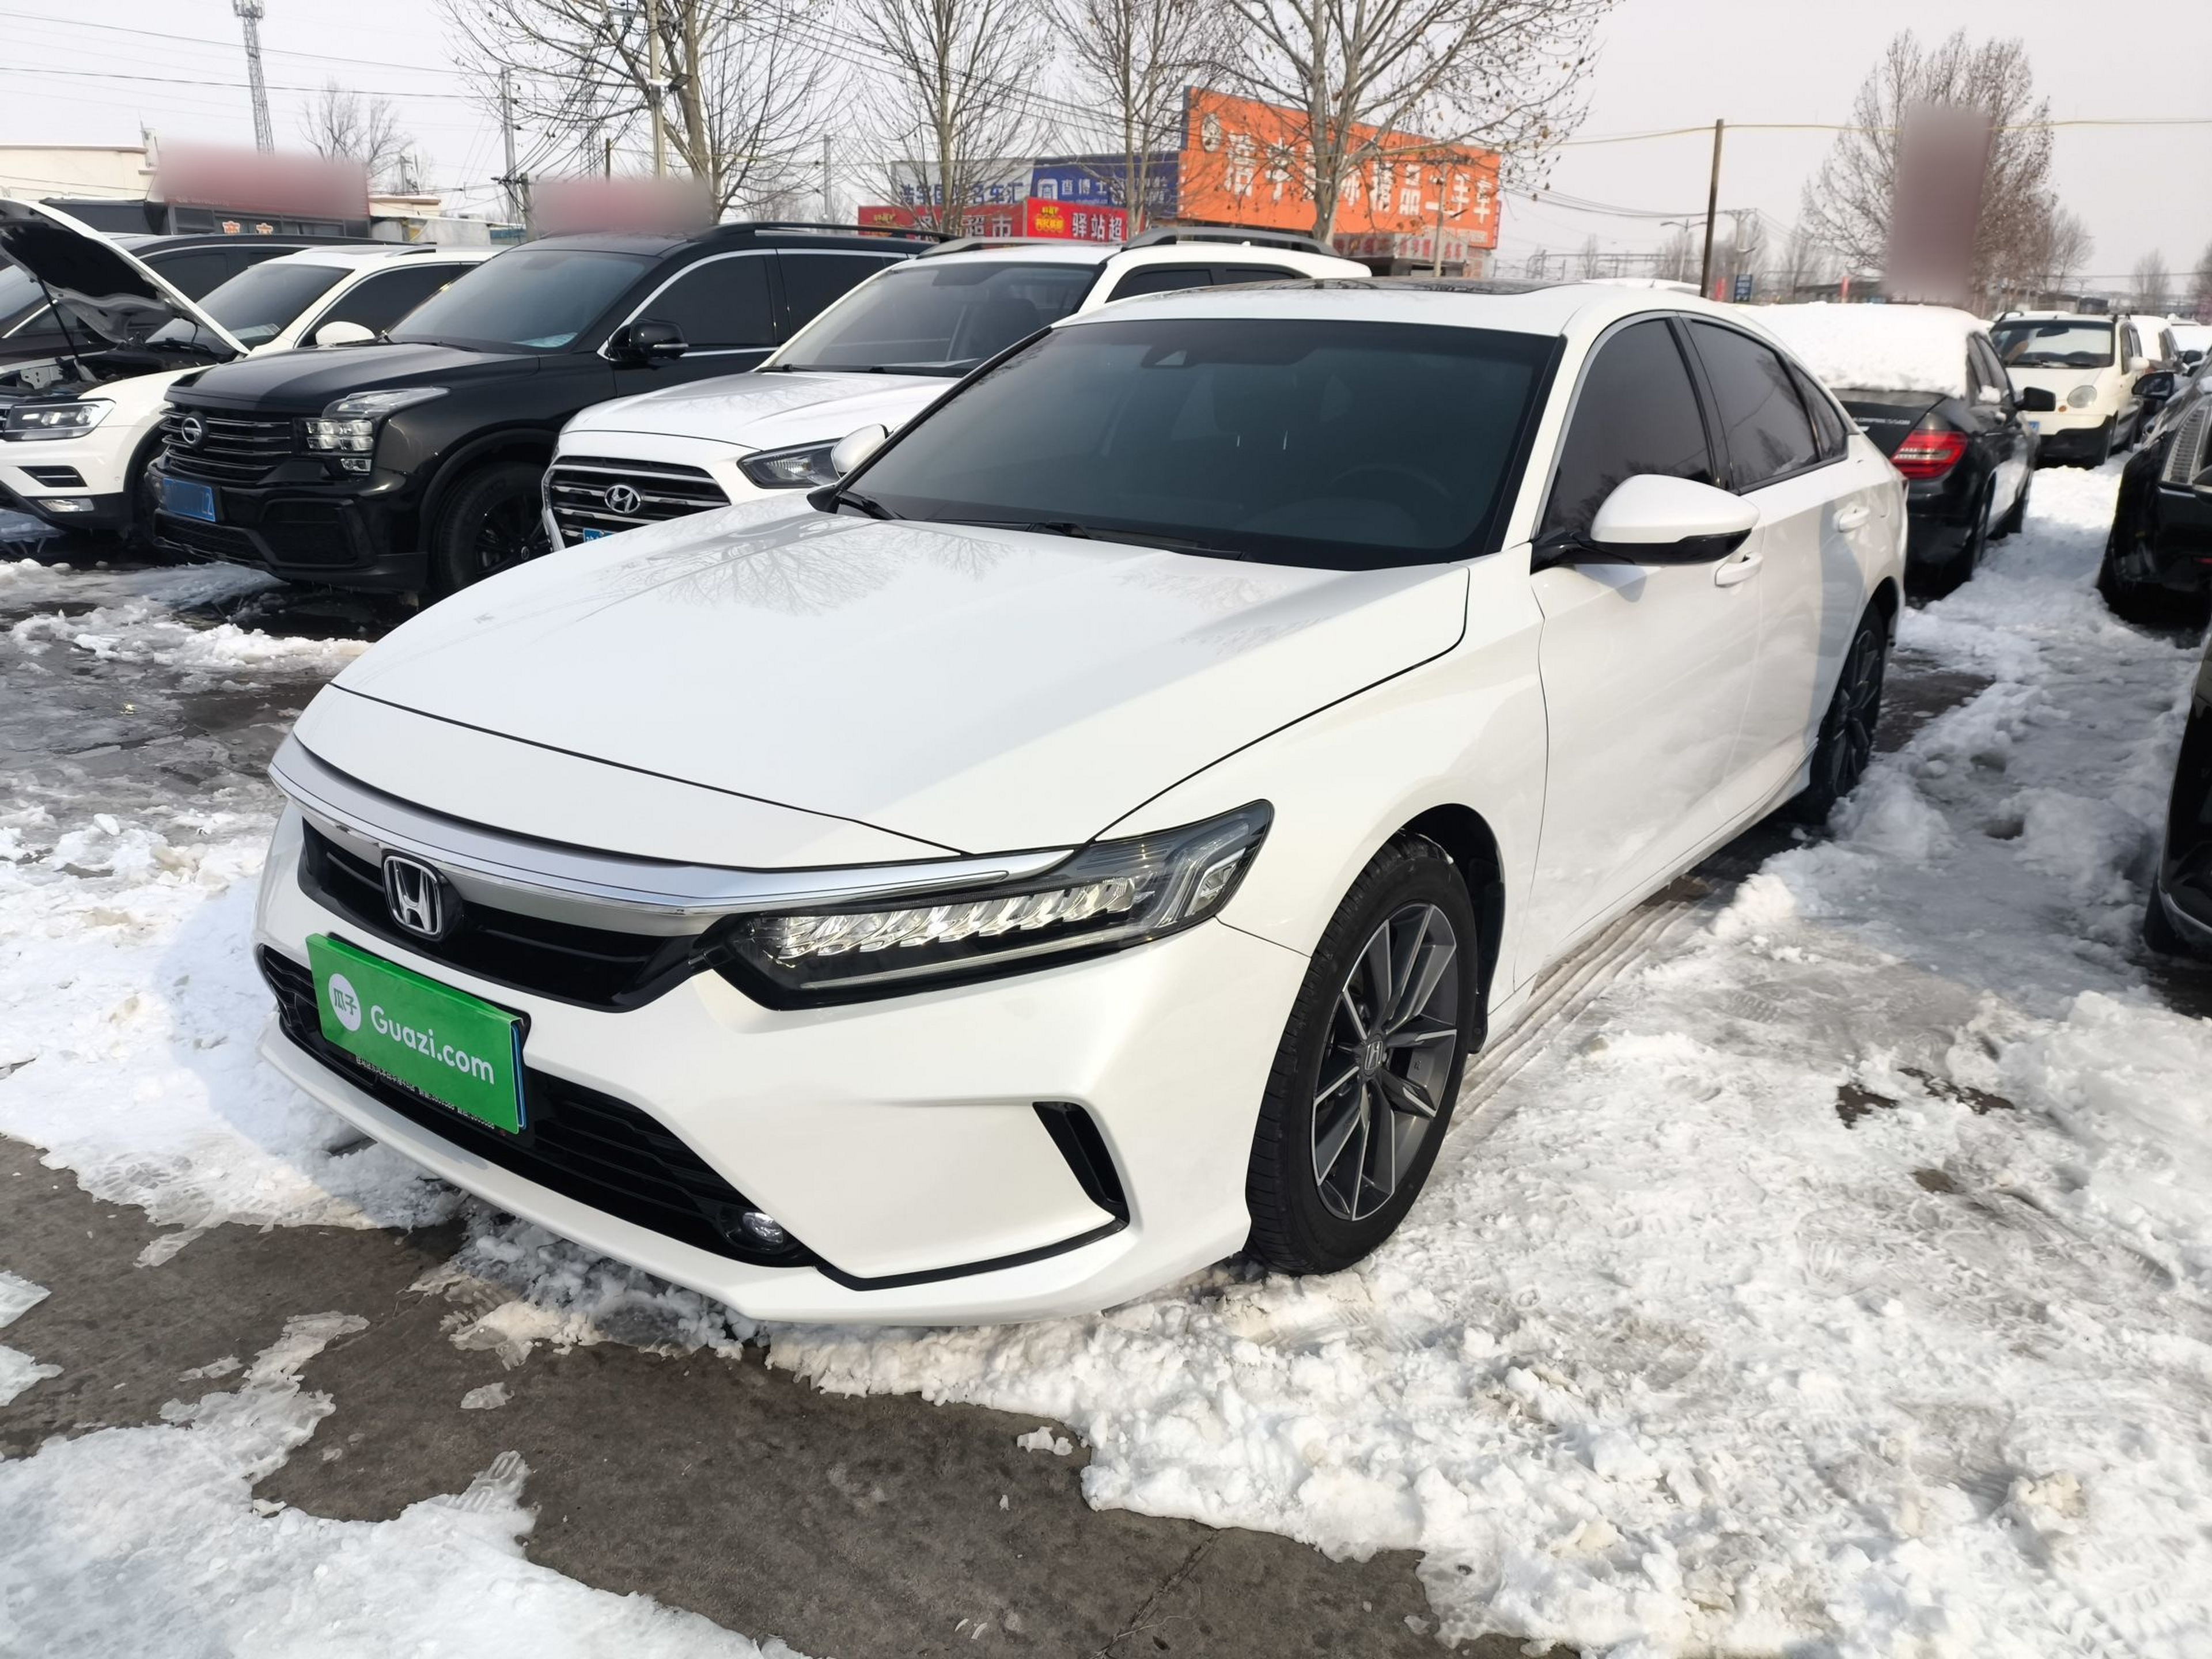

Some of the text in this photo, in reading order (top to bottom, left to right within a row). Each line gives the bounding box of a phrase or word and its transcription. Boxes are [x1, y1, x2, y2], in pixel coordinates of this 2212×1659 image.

[1062, 178, 1107, 195] 查博士
[1072, 212, 1128, 241] 驿站超
[334, 987, 358, 1016] 瓜子
[370, 1005, 495, 1085] Guazi.com
